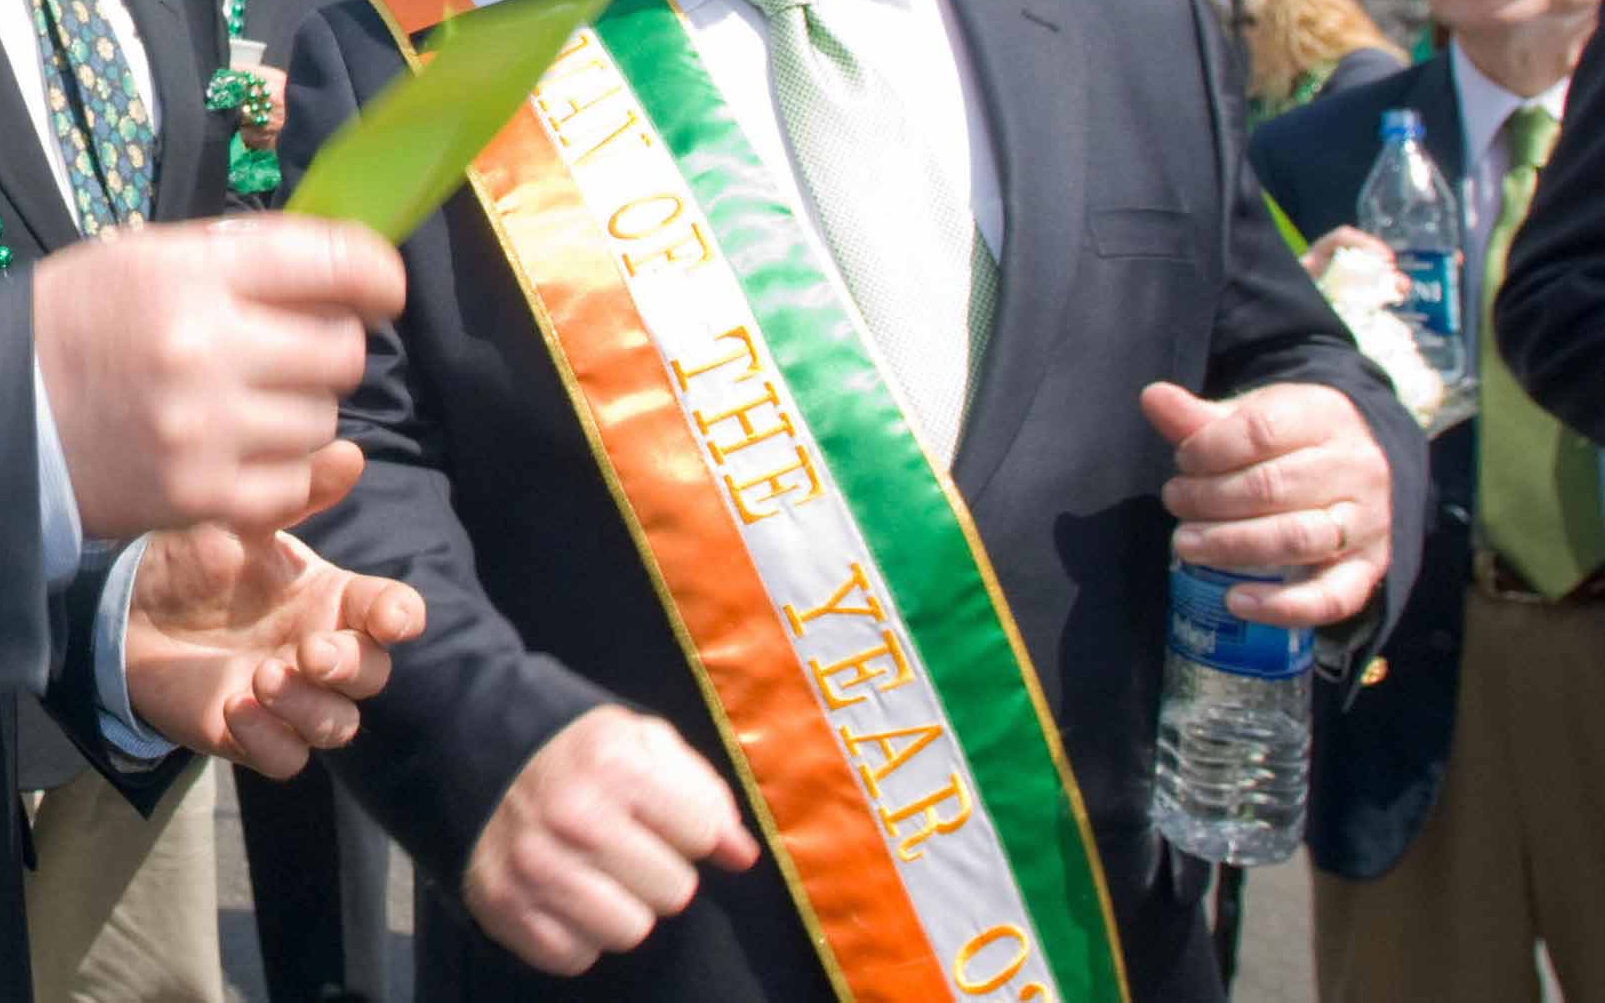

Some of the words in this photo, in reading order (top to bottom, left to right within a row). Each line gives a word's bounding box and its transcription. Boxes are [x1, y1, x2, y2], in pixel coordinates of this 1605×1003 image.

[607, 192, 712, 278] OF
[669, 324, 825, 525] THE
[783, 562, 973, 863] YEAR
